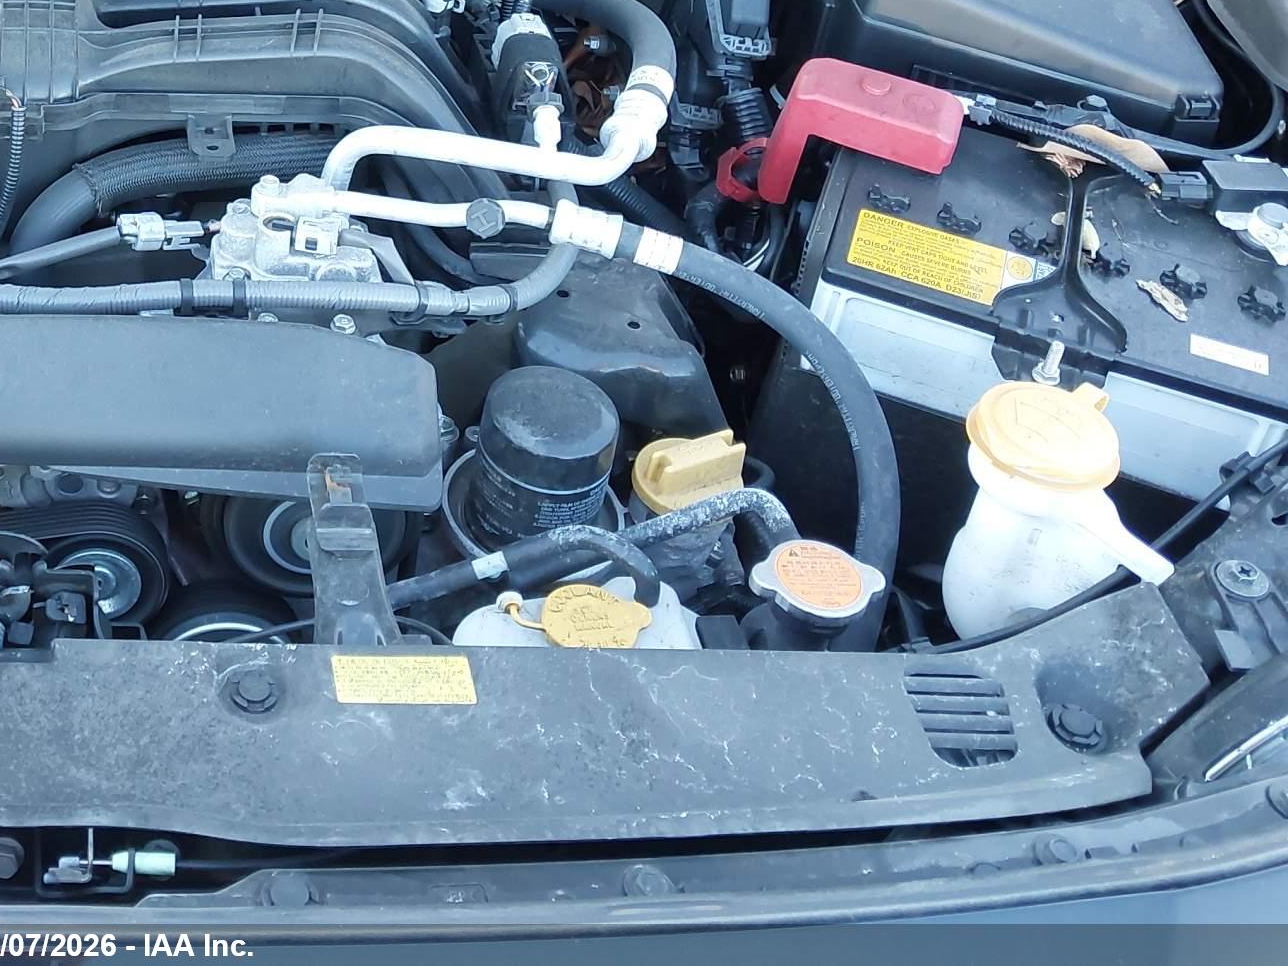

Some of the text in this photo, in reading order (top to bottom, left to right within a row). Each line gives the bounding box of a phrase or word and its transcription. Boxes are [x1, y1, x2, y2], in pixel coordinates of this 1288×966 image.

[863, 212, 904, 228] DANGER
[856, 237, 896, 252] POISON
[900, 271, 920, 281] CCA
[920, 277, 942, 288] 620A
